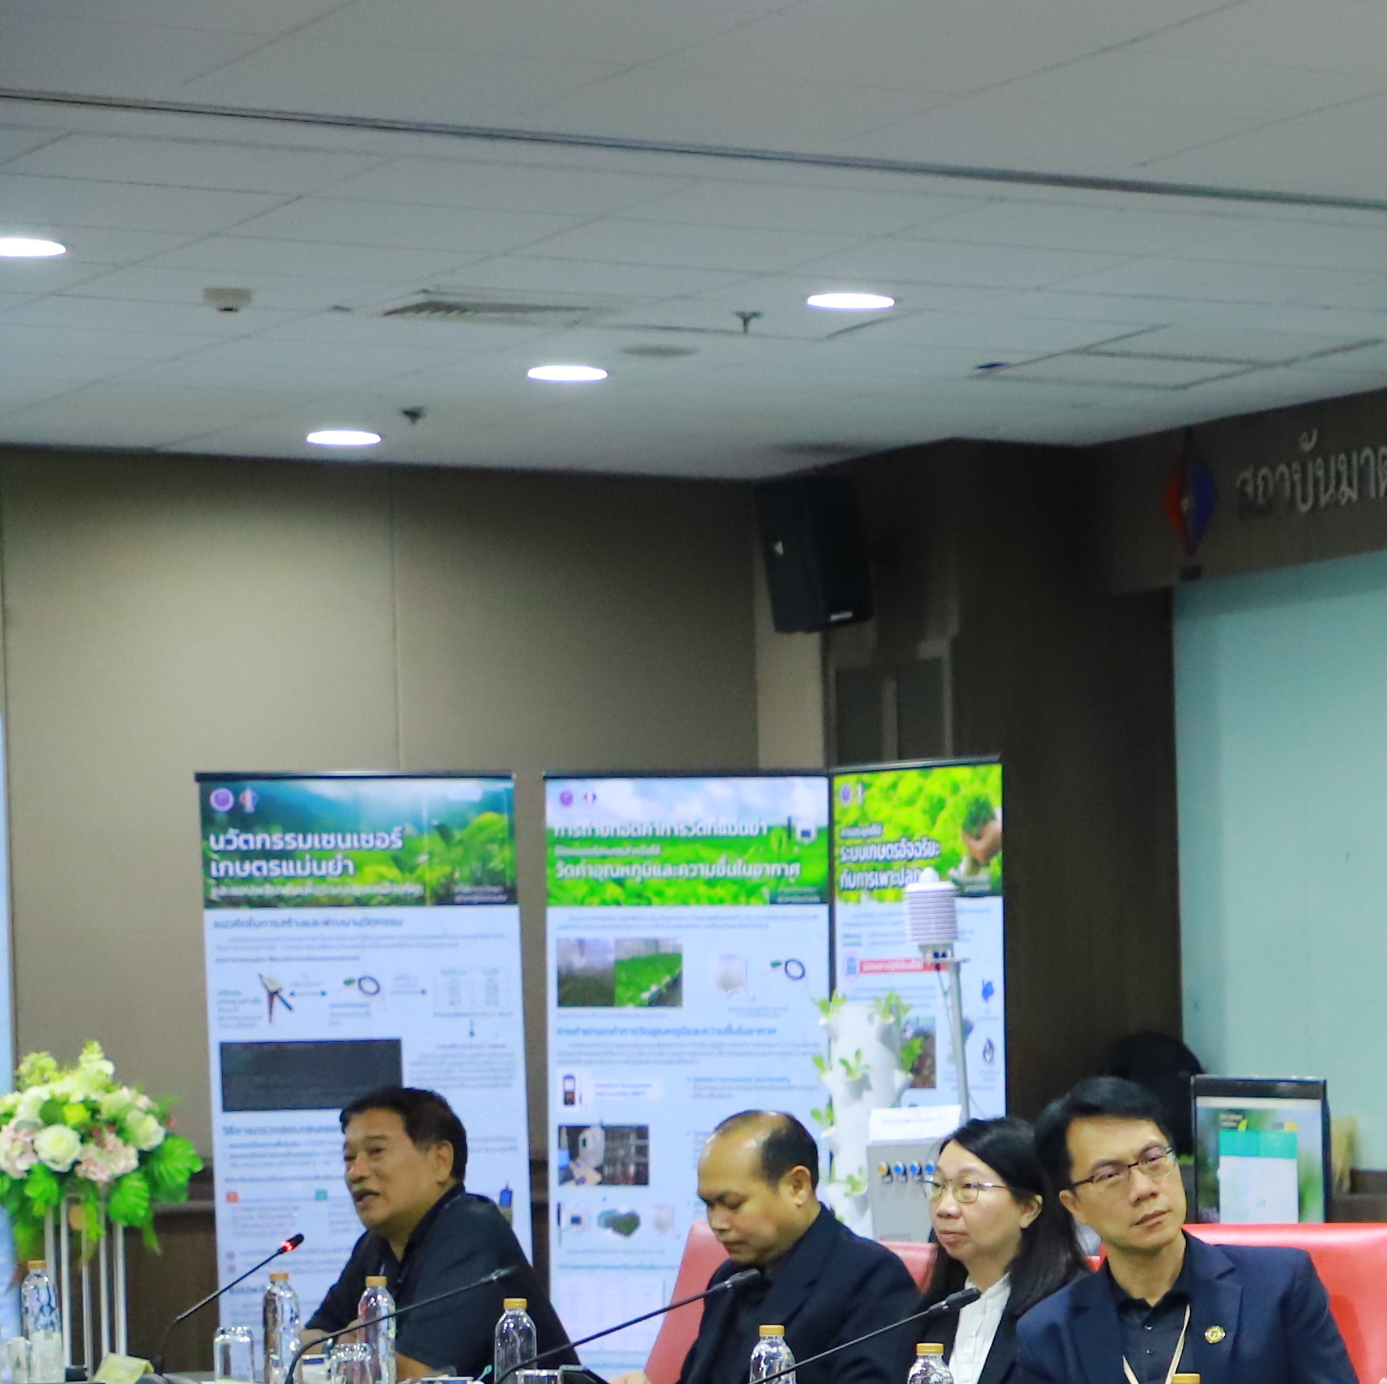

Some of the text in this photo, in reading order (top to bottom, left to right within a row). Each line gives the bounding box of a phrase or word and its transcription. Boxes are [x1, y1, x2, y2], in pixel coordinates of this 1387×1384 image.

[209, 826, 404, 851] นวัตกรรมเซนเซอร์
[210, 853, 355, 878] เกษตรแม่นยำ
